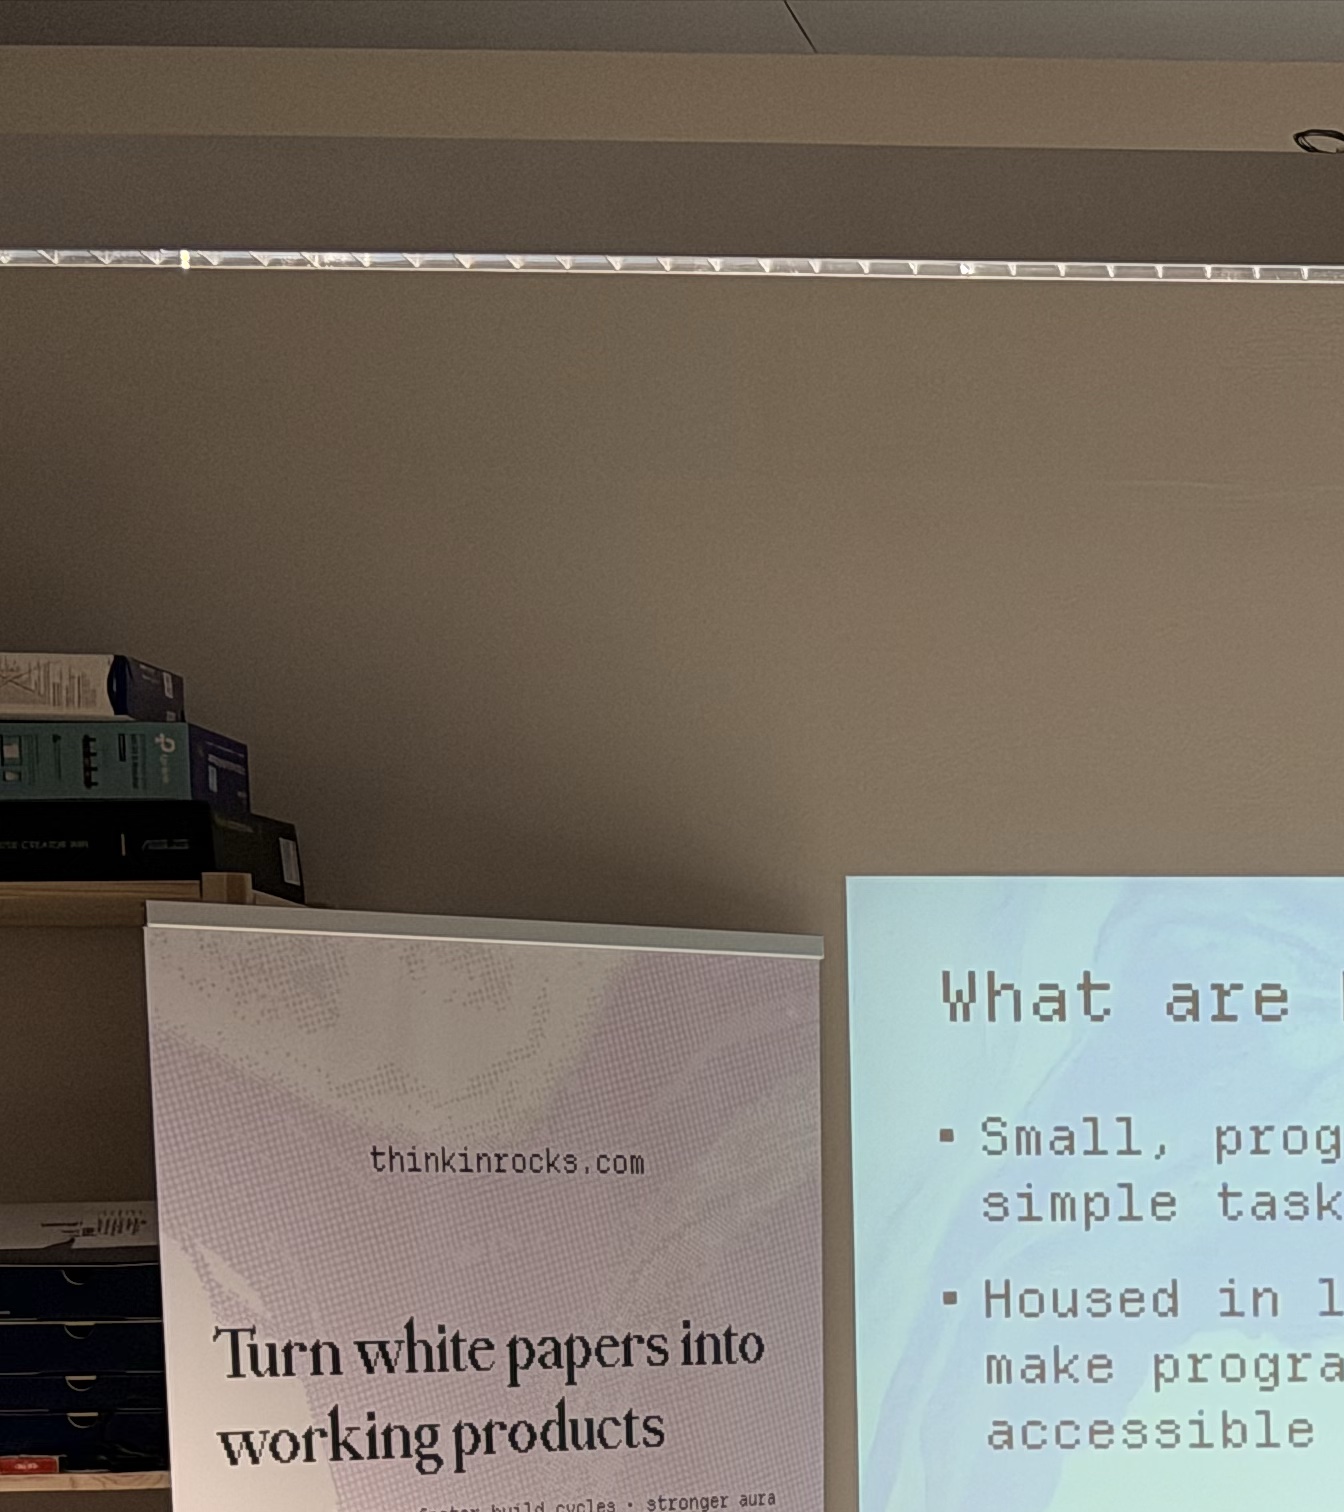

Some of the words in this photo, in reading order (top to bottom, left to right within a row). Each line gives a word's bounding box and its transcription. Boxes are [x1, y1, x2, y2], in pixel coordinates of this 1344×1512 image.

[942, 970, 1111, 1023] What
[1166, 980, 1289, 1023] are
[370, 1145, 644, 1175] thinkinrocks.com
[981, 1116, 1168, 1161] Small,
[982, 1182, 1177, 1232] simple
[984, 1278, 1180, 1319] Housed
[1218, 1278, 1280, 1318] in
[212, 1325, 342, 1378] Turn
[353, 1316, 494, 1373] white
[506, 1327, 668, 1386] papers
[679, 1320, 764, 1368] into
[986, 1346, 1114, 1385] make
[216, 1404, 442, 1475] working
[452, 1396, 665, 1474] products
[987, 1410, 1315, 1451] accessible
[738, 1491, 775, 1507] aura
